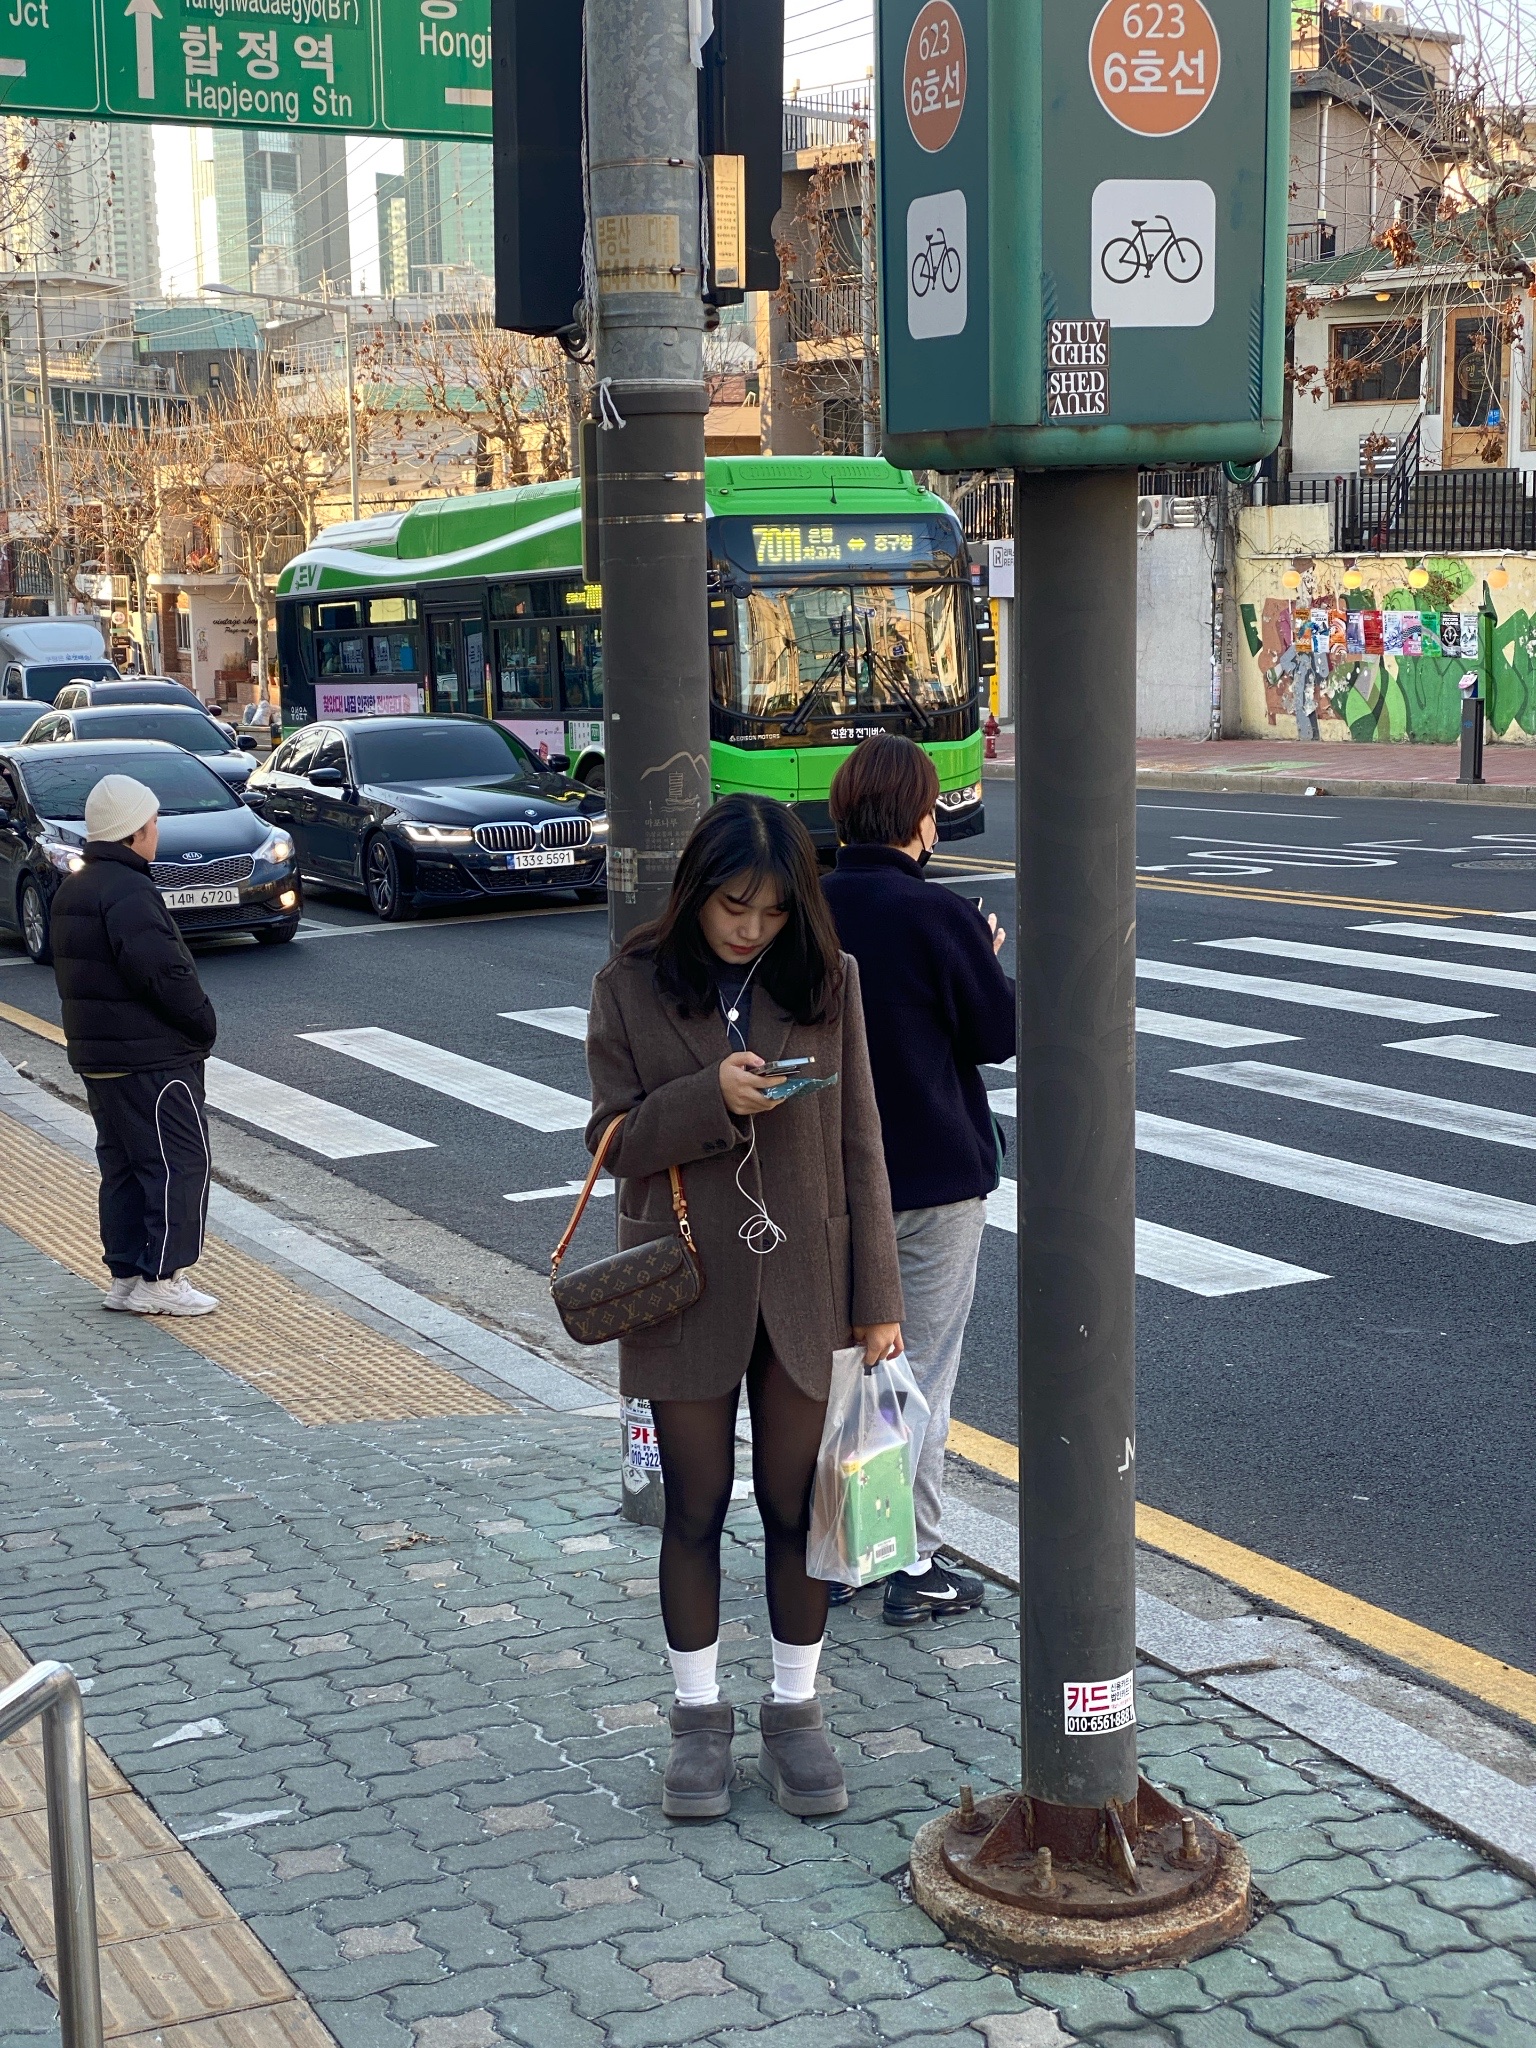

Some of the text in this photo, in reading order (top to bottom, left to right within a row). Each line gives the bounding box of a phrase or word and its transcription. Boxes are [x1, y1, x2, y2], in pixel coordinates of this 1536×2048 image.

[9, 0, 49, 28] Jct
[185, 0, 359, 25] gwadaegyo(Br)
[1123, 3, 1185, 38] 623
[919, 19, 950, 60] 623
[1103, 49, 1205, 95] 6호선
[911, 60, 960, 116] 6호선
[185, 78, 353, 122] Hapjeong Stn
[1051, 322, 1106, 344] STUV
[1051, 343, 1106, 365] SHED
[1050, 371, 1105, 394] SHED
[1051, 392, 1105, 415] STUV
[299, 564, 318, 588] EV
[212, 617, 241, 627] vintage
[830, 727, 855, 739] 친환경
[644, 817, 678, 828] 마포나루
[183, 852, 202, 860] KIA
[515, 852, 571, 868] 133오 5591
[169, 890, 232, 906] 14머 6720
[1067, 1685, 1110, 1713] 카드
